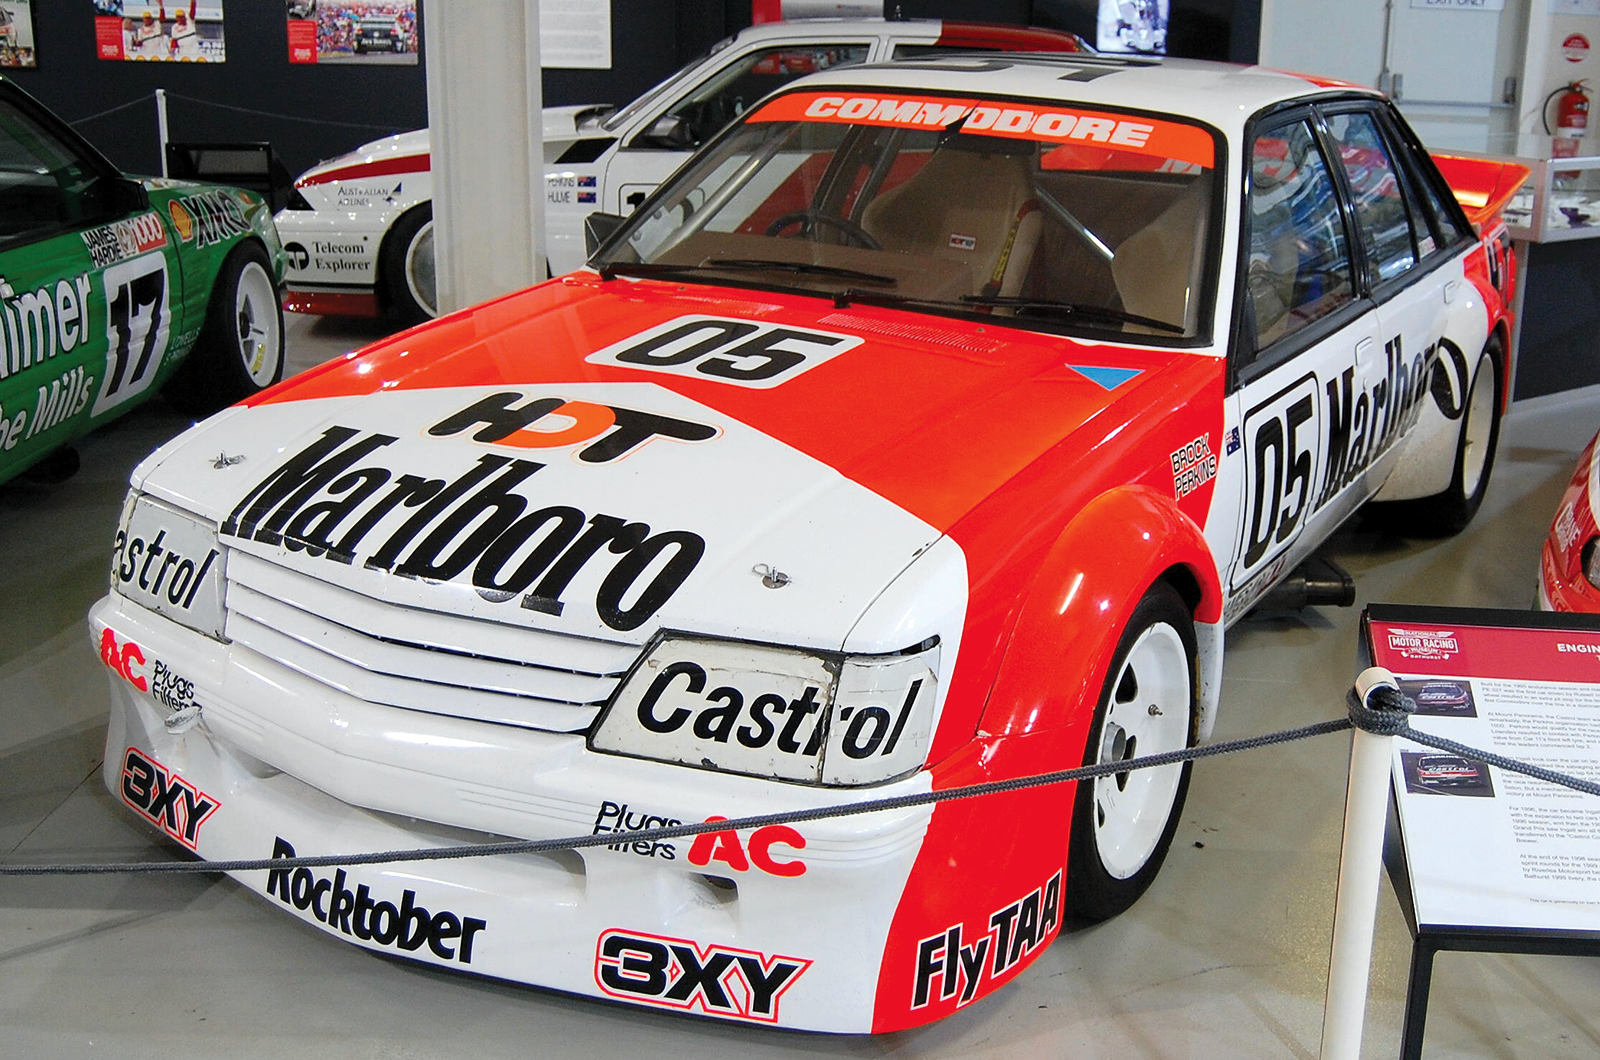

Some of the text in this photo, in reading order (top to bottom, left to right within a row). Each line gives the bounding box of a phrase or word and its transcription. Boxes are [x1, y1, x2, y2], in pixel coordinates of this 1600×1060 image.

[804, 96, 1154, 148] COMMODORE
[84, 226, 118, 249] JAMES
[91, 243, 124, 270] HARDIE
[312, 242, 364, 254] Telecom
[315, 258, 371, 273] Explorer
[105, 267, 165, 398] 17
[616, 318, 847, 382] 05
[25, 365, 94, 440] Mills
[427, 391, 719, 463] HDT
[1313, 332, 1469, 515] Marlboro
[1170, 433, 1211, 474] BROCK
[1173, 455, 1218, 501] PERKINS
[1243, 391, 1314, 569] 05
[219, 425, 706, 632] Marlboro
[100, 627, 148, 693] AC
[1392, 637, 1454, 649] MOTOR RACING
[152, 681, 203, 712] Filter
[153, 659, 195, 699] Plugs
[637, 661, 924, 760] Castrol
[122, 747, 220, 849] 3XY
[687, 815, 808, 878] AC
[266, 836, 487, 964] Rocktober
[596, 929, 810, 1020] 3XY
